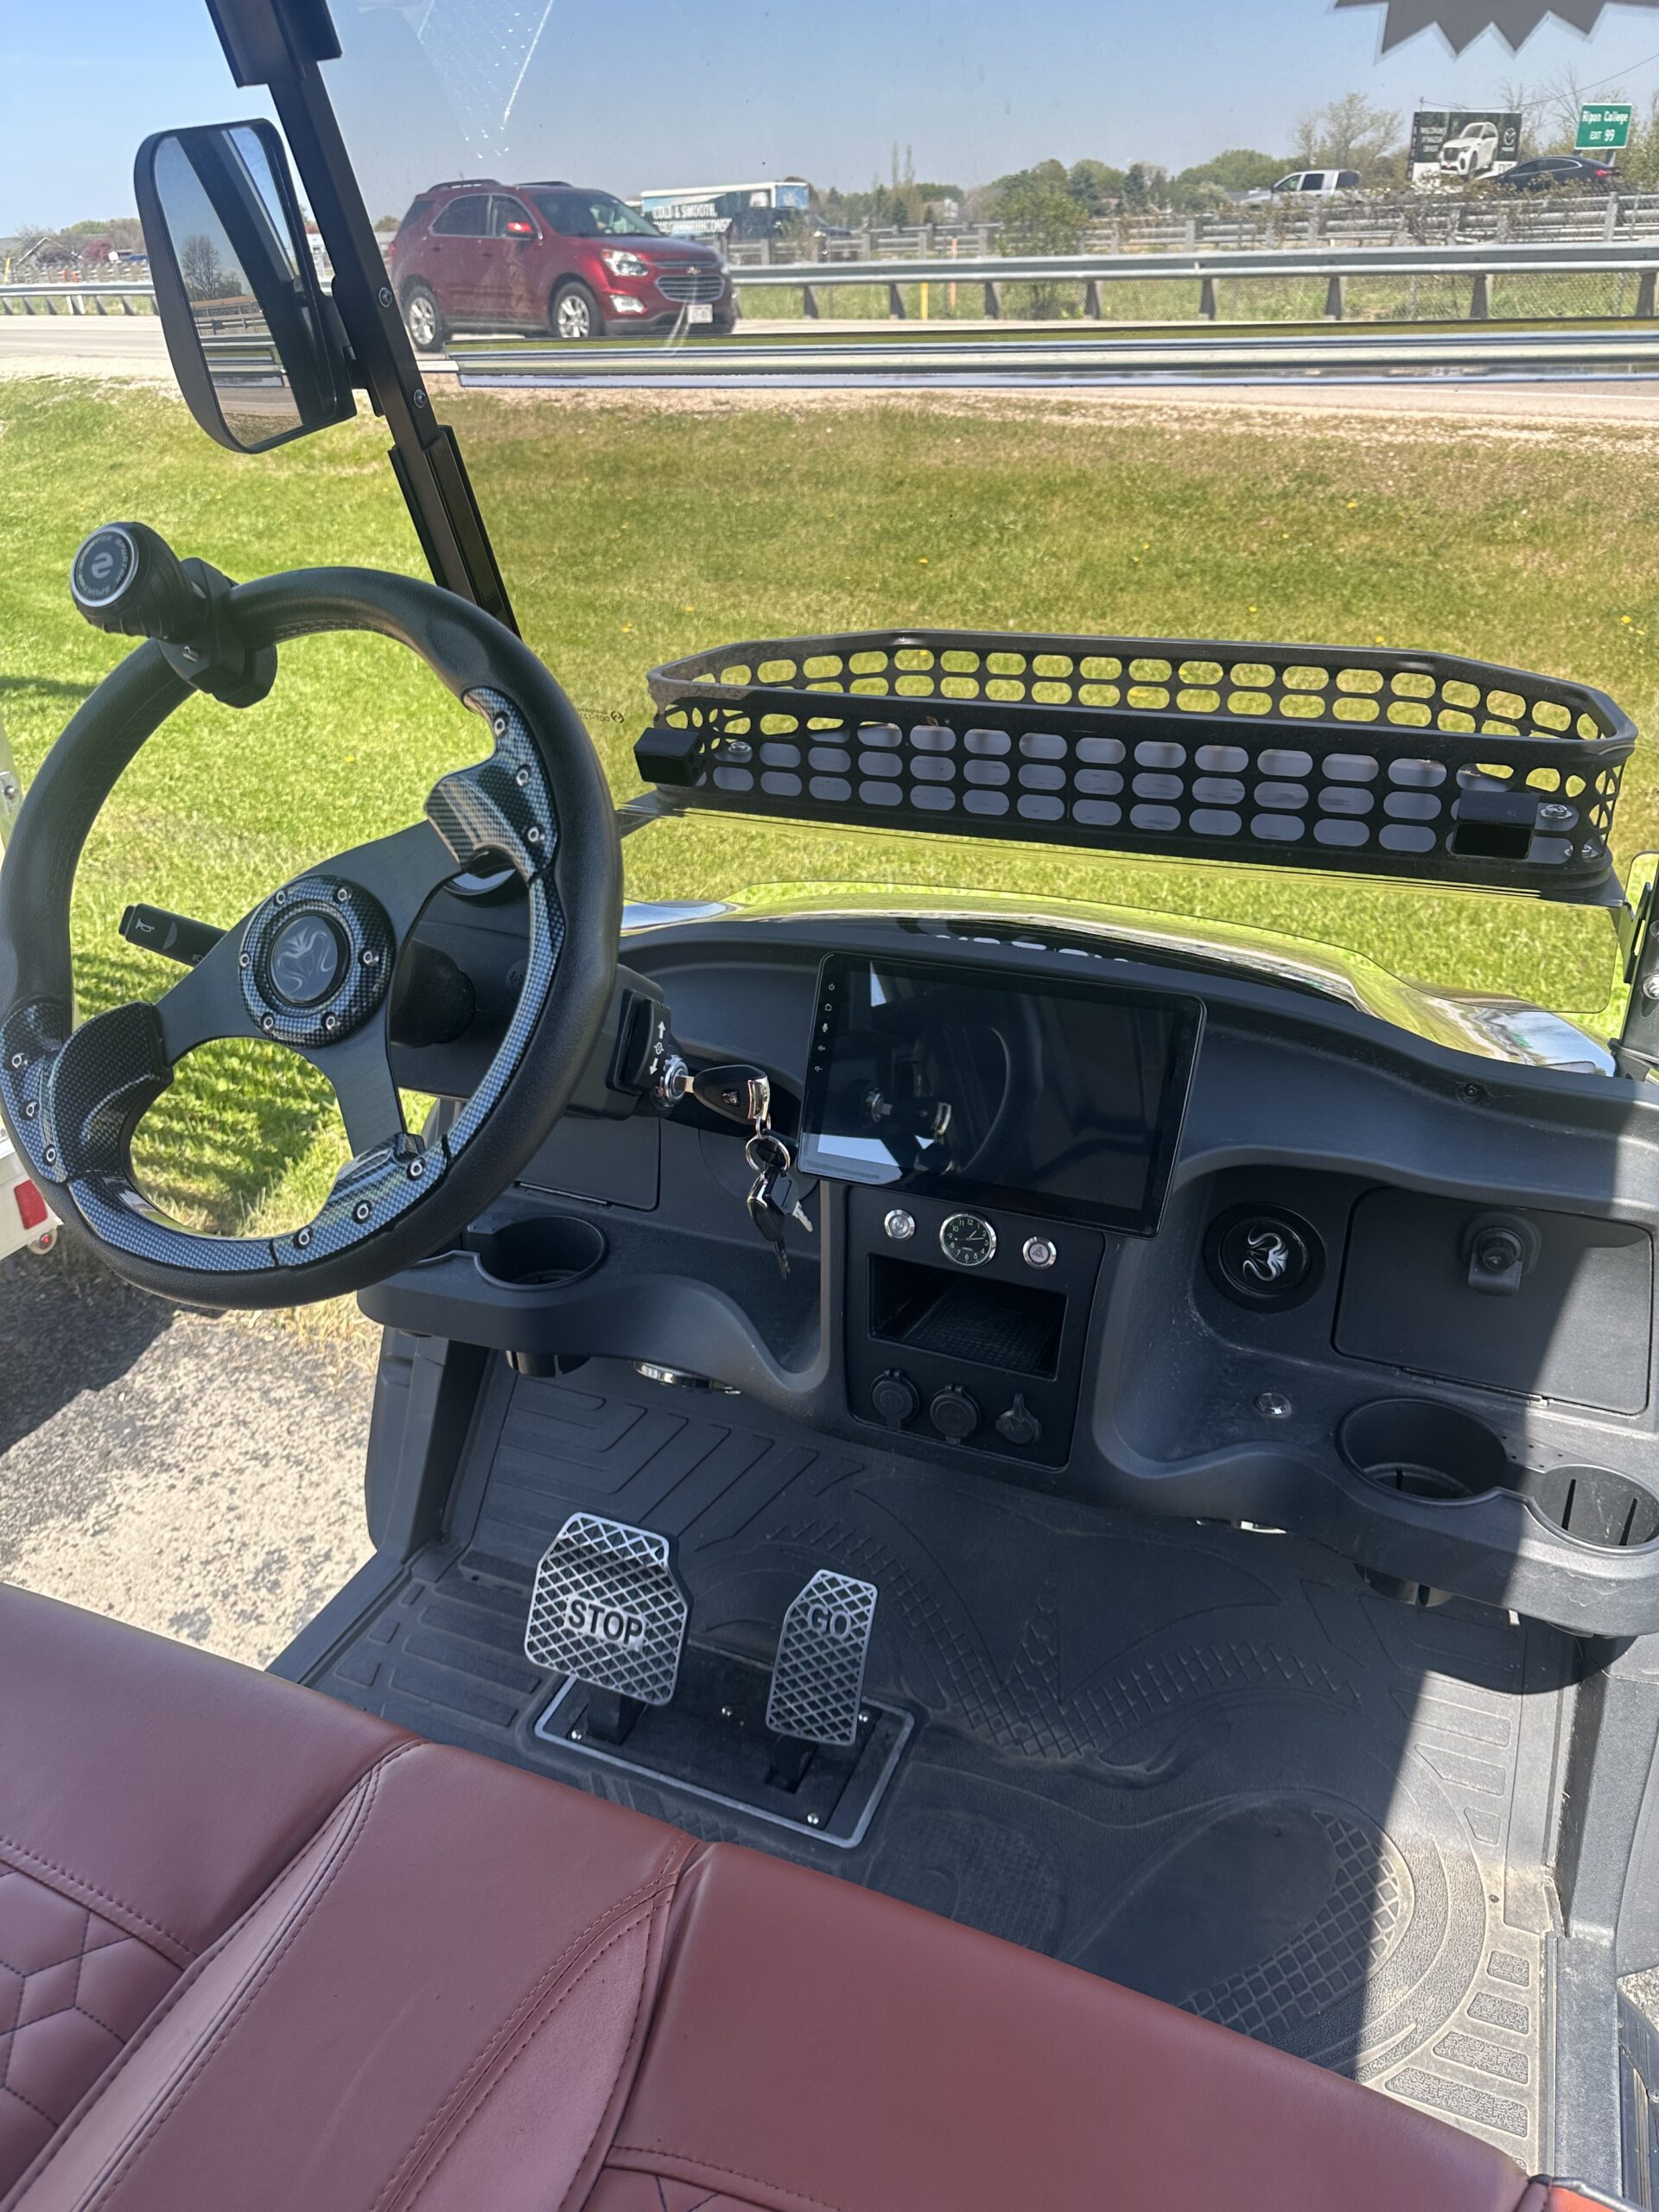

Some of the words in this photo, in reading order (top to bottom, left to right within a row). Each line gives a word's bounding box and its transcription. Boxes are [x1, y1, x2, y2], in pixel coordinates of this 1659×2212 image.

[1582, 110, 1602, 124] Ripon
[1604, 110, 1629, 125] College
[1590, 130, 1603, 140] EXIT
[1605, 129, 1616, 142] 99
[567, 1599, 645, 1644] STOP
[806, 1603, 853, 1640] GO
